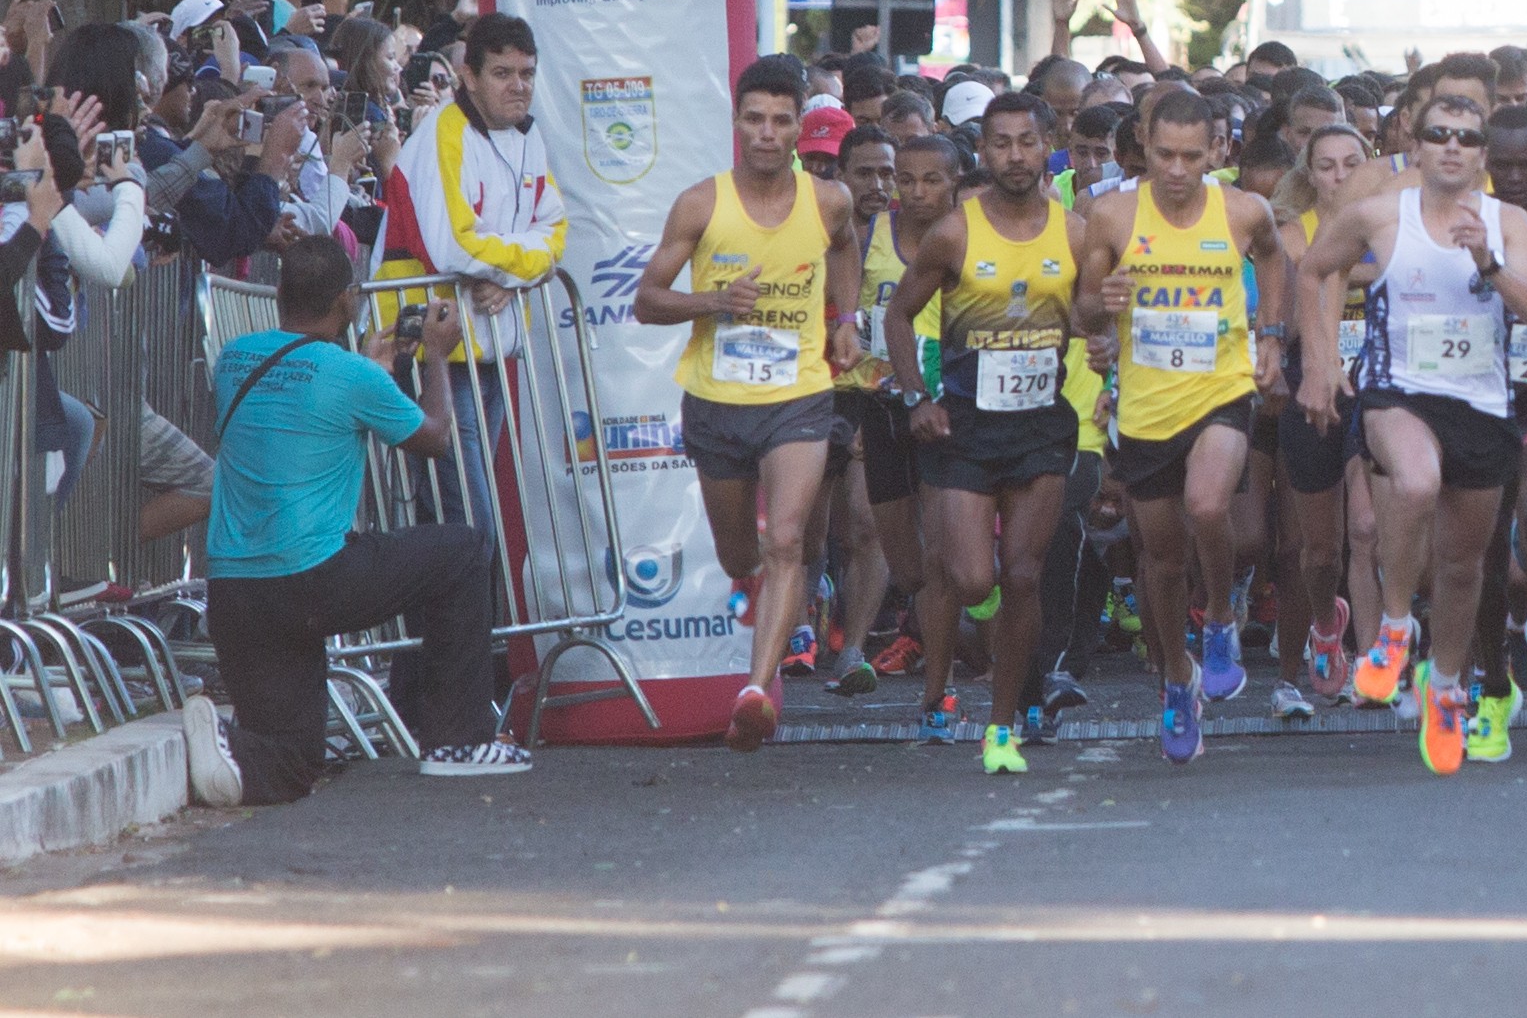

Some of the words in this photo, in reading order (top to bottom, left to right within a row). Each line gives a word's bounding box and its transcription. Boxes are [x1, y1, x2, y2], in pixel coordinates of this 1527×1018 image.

[1136, 285, 1224, 309] CAIXA
[1149, 332, 1207, 344] MARCELO
[1170, 348, 1185, 368] 8
[1441, 339, 1472, 359] 29
[747, 362, 773, 382] 15
[996, 372, 1049, 395] 1270
[651, 460, 669, 471] DA
